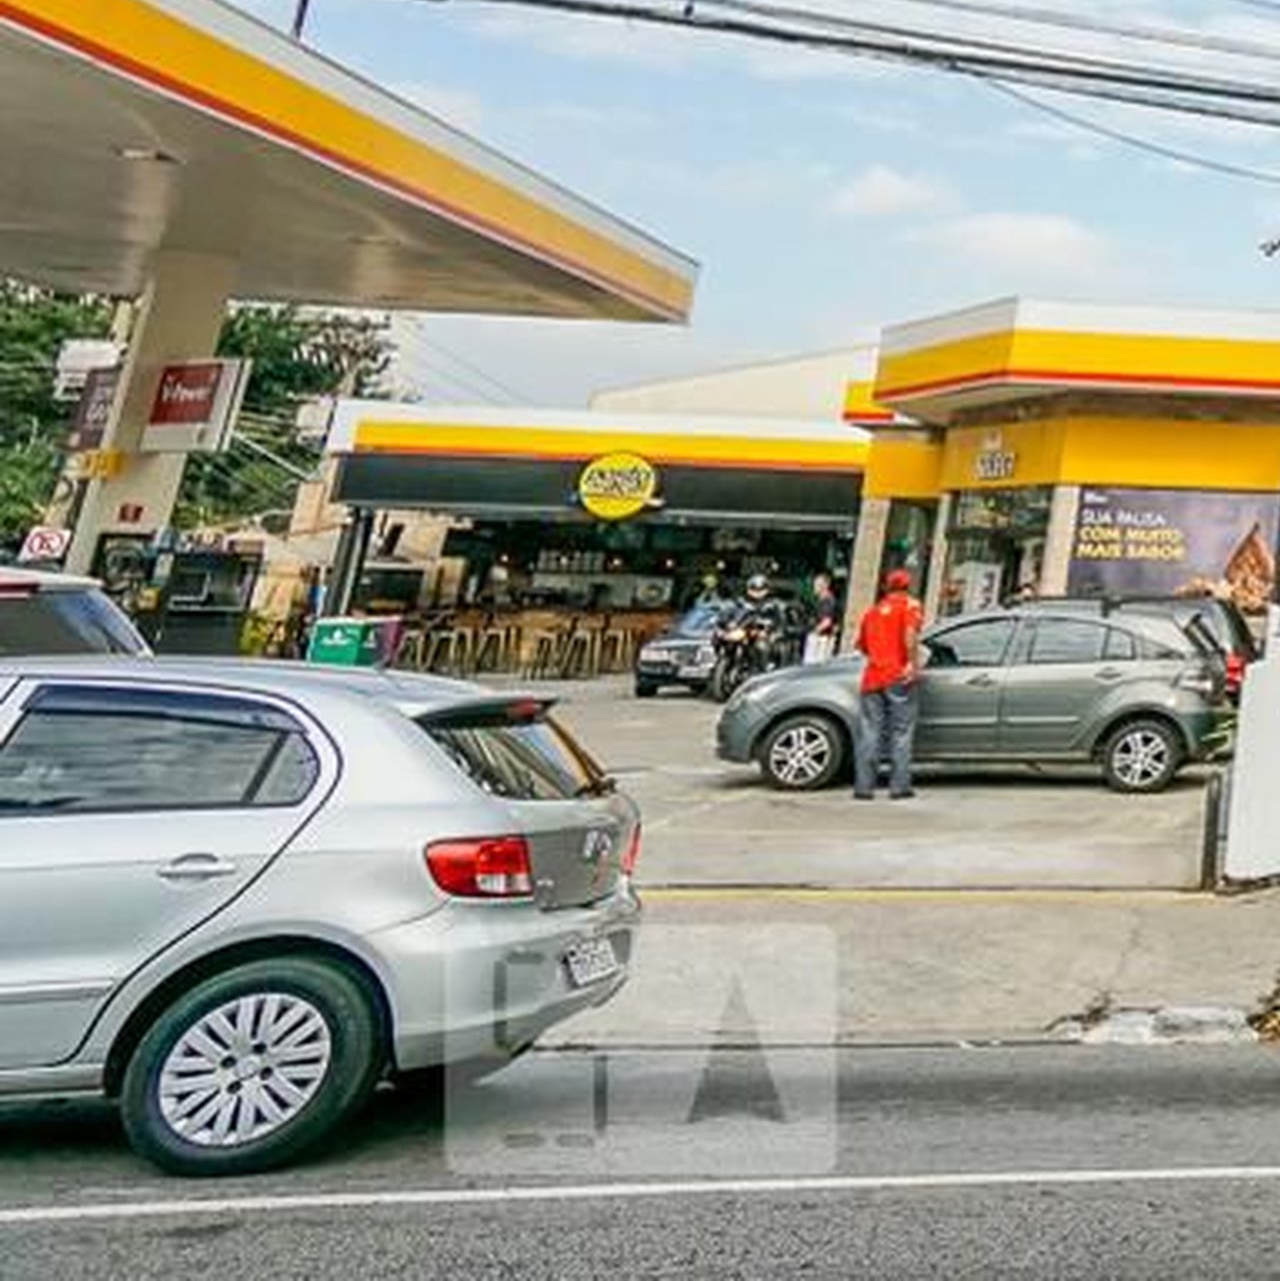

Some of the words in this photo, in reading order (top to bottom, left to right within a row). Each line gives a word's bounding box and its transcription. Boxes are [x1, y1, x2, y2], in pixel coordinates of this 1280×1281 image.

[1081, 507, 1112, 525] SUA
[1080, 526, 1122, 541] COM
[1077, 542, 1121, 559] MAIS
